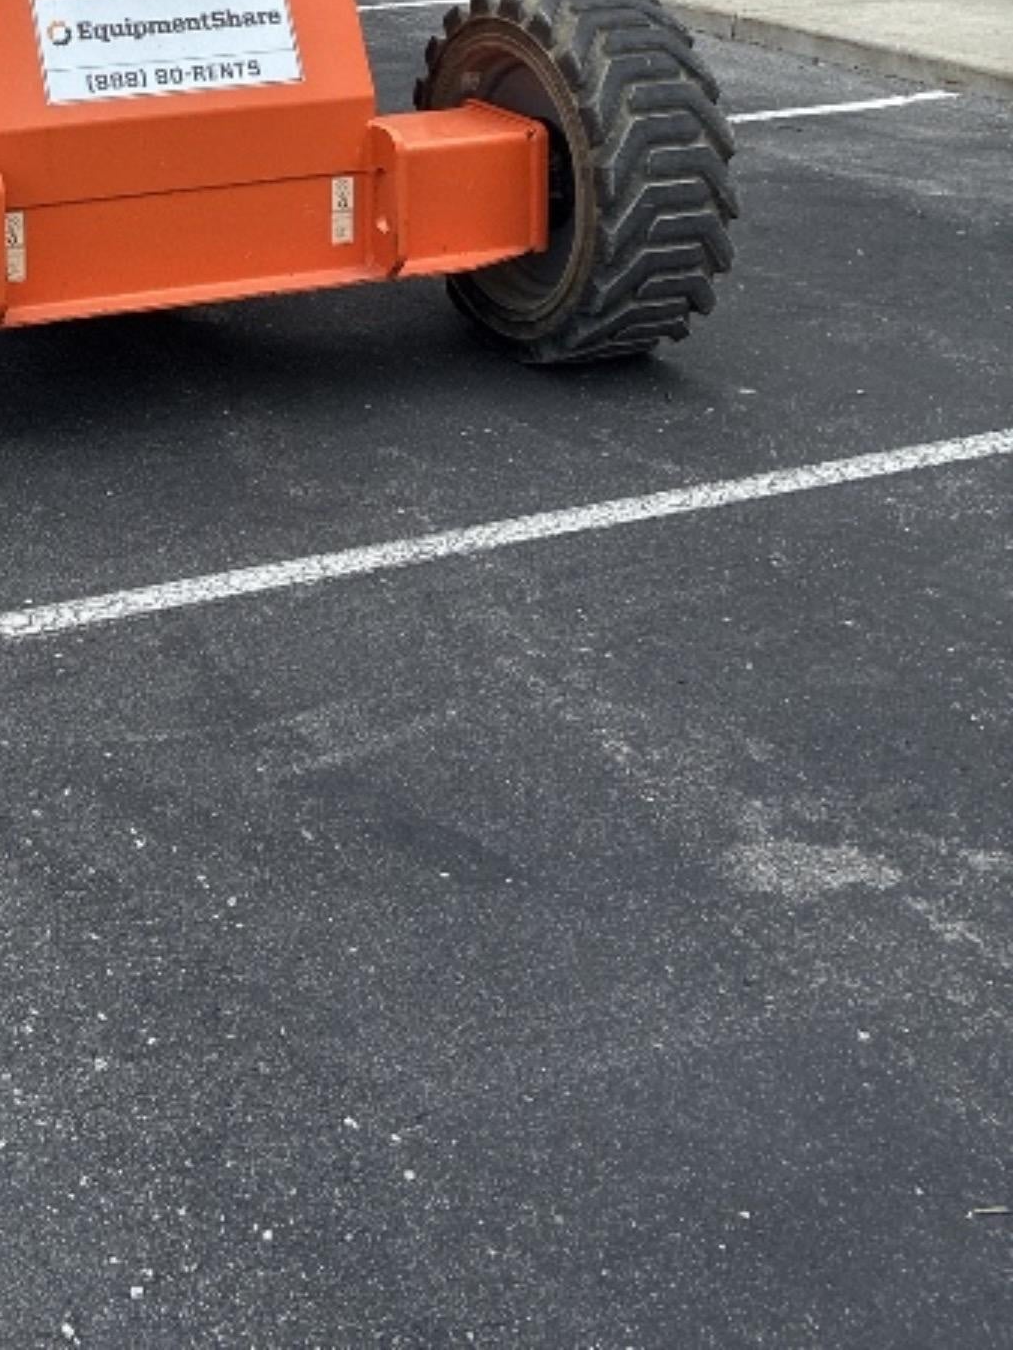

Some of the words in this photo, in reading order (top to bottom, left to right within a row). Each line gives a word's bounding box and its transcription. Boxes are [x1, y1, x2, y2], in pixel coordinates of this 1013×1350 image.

[76, 8, 282, 43] EquipmentShare
[86, 68, 147, 93] (888)
[155, 60, 261, 85] 80-RENTS
